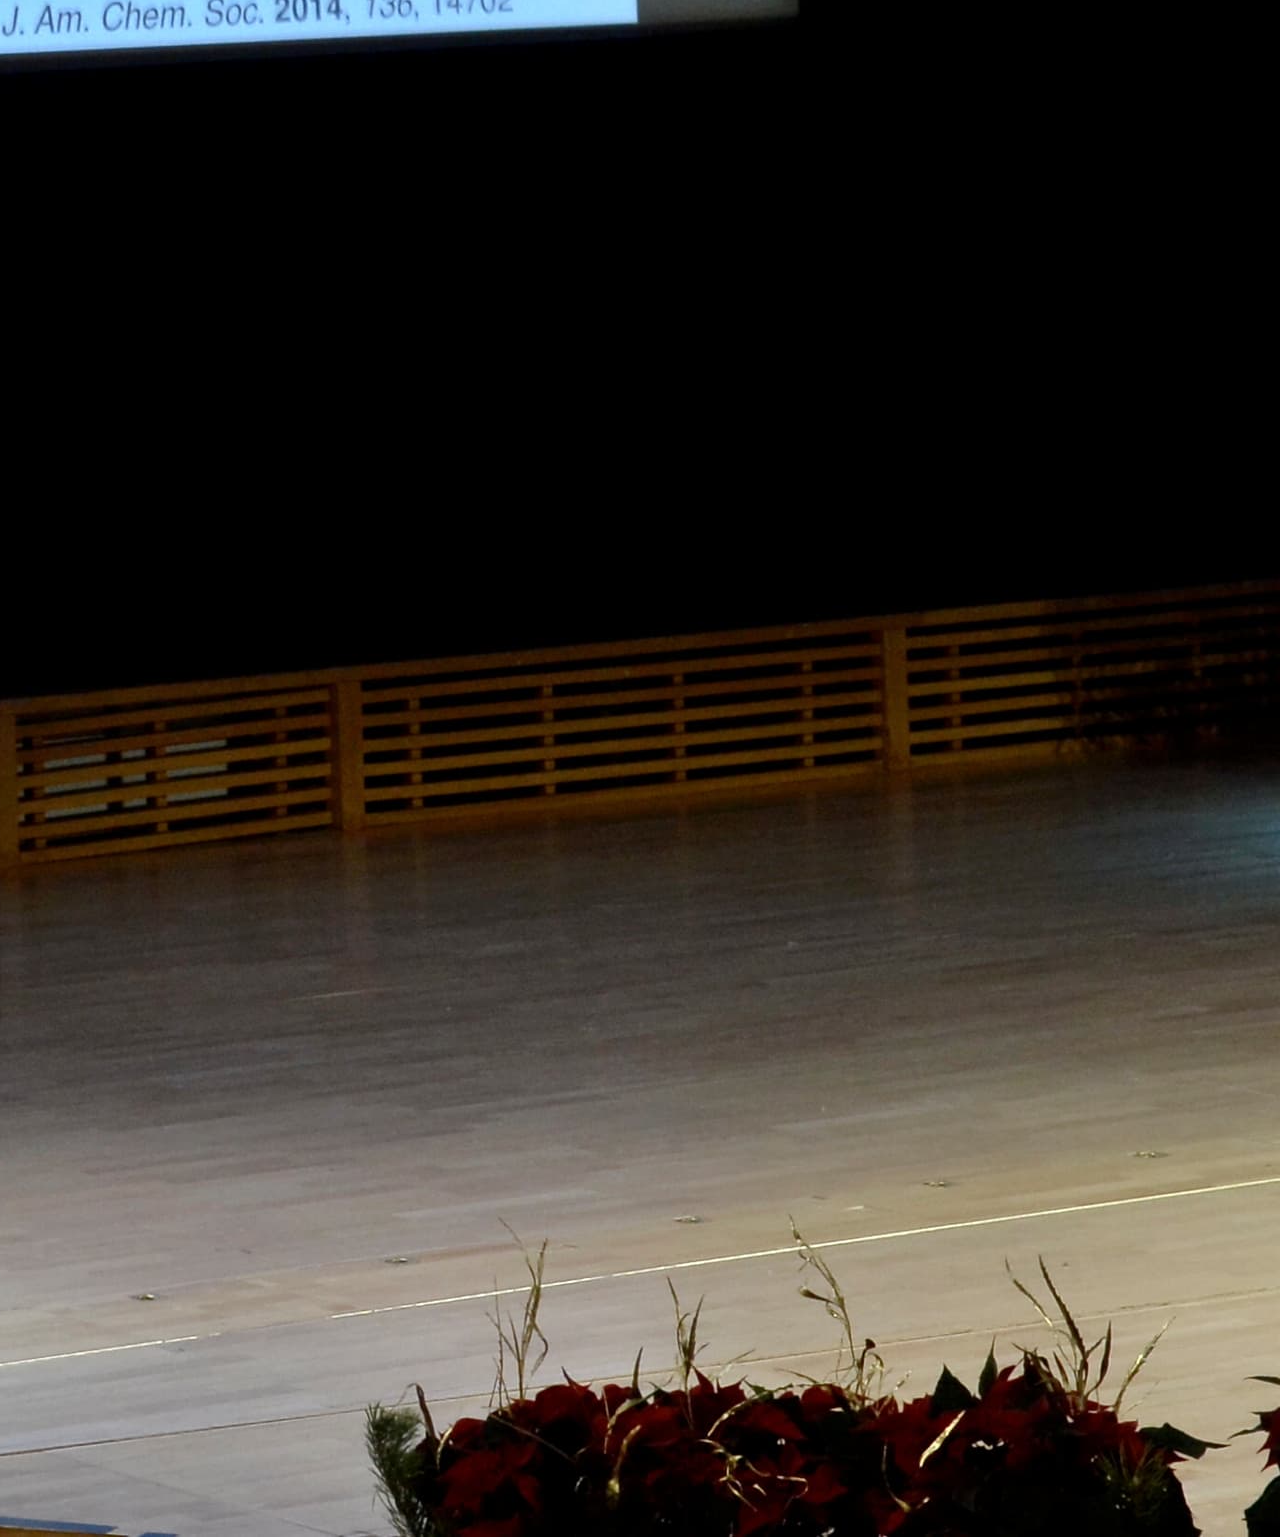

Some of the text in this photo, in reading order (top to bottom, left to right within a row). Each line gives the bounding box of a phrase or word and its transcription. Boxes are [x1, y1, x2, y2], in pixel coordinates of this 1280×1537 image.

[1, 5, 25, 37] J.
[34, 4, 90, 34] Am.
[102, 0, 193, 32] Chem.
